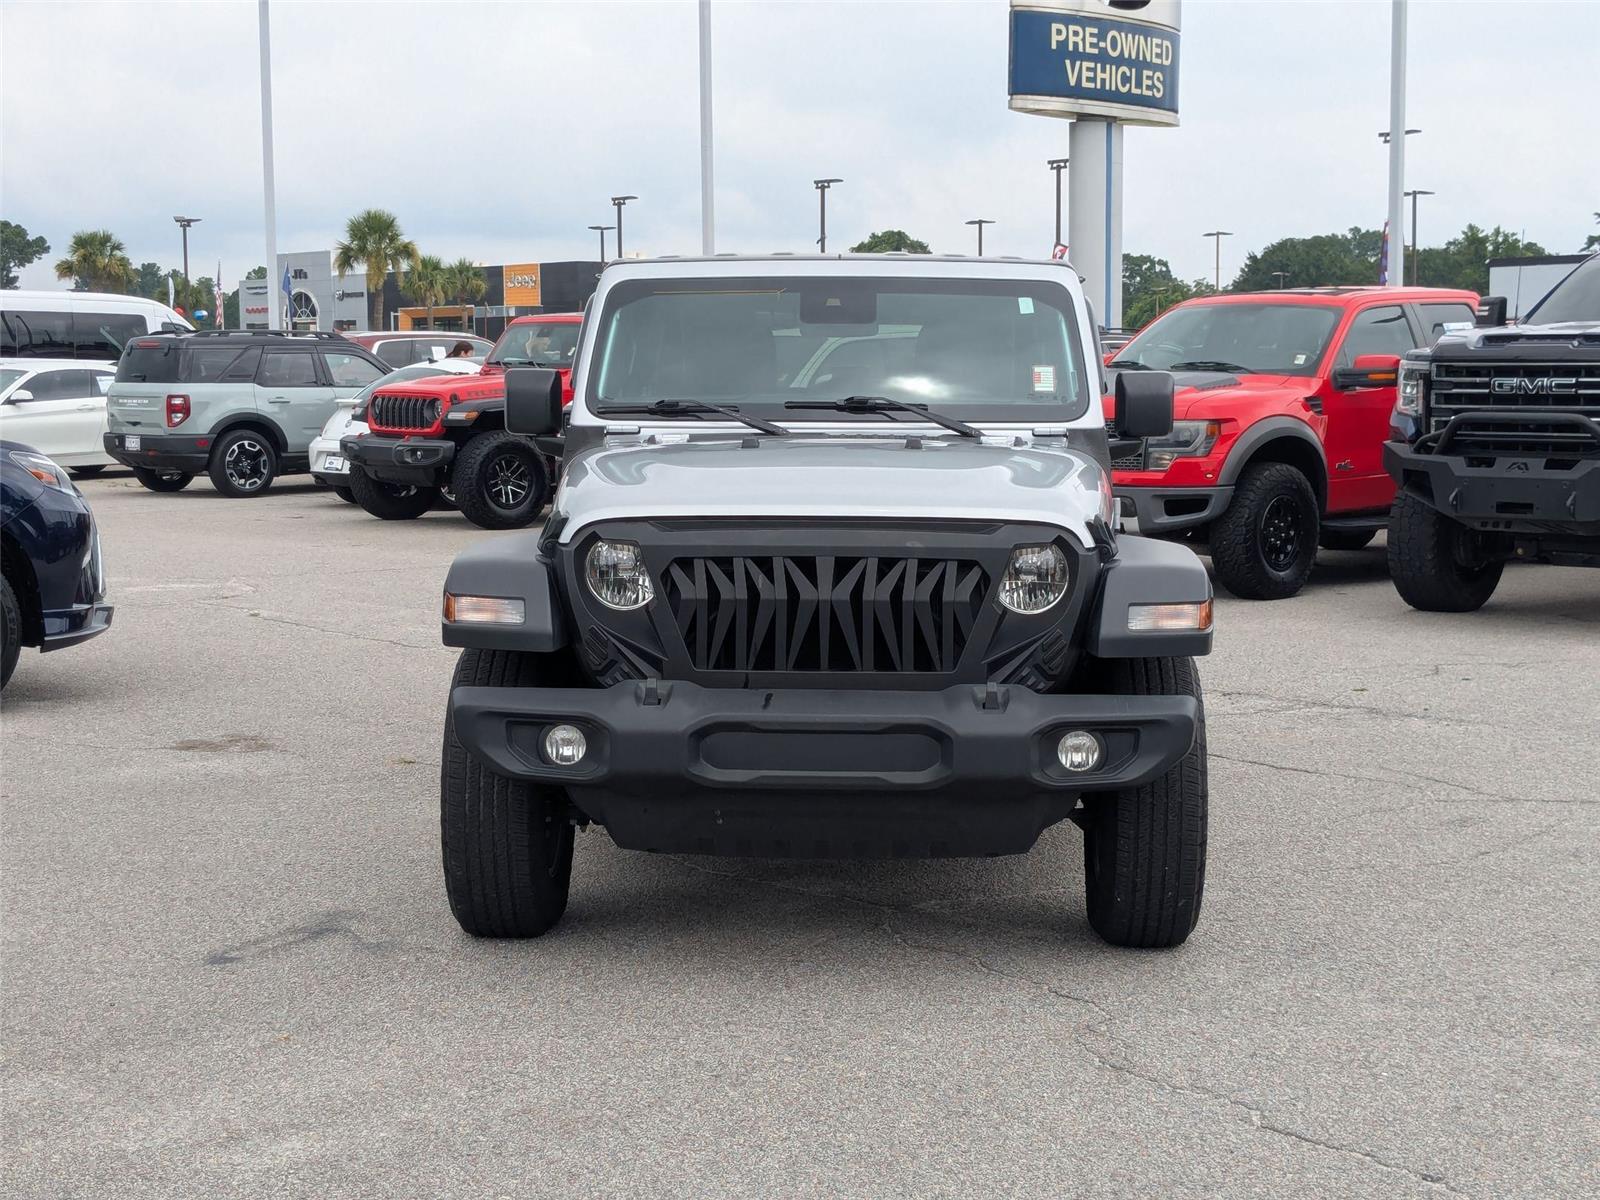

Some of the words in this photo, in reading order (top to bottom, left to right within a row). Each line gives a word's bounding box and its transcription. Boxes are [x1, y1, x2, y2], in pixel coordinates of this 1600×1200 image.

[1051, 23, 1172, 66] PRE-OWNED
[1065, 60, 1164, 98] VEHICLES
[506, 272, 536, 289] Jeep
[1491, 377, 1576, 395] GMC
